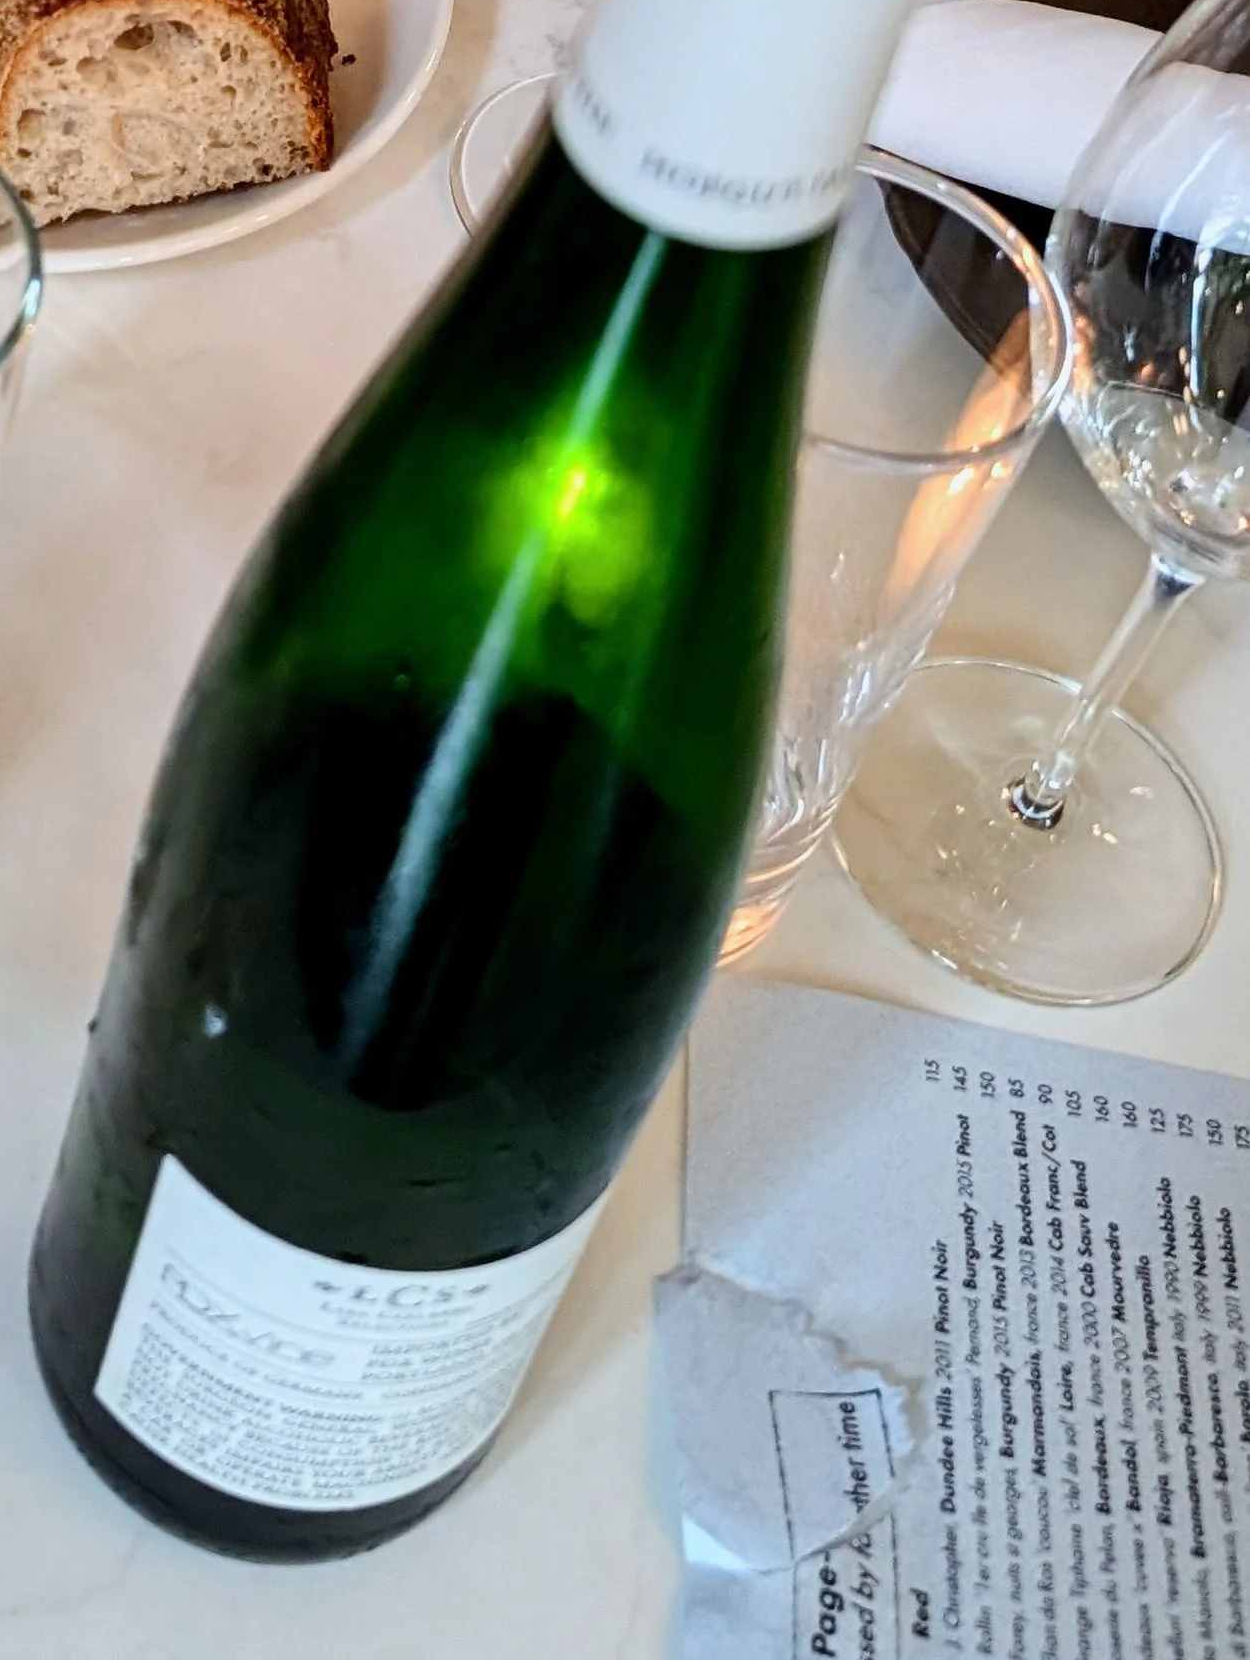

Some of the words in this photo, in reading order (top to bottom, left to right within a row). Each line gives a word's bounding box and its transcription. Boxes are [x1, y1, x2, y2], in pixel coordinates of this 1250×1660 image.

[924, 1059, 940, 1082] 115
[952, 1066, 967, 1093] 145
[980, 1071, 995, 1098] 150
[1008, 1078, 1024, 1098] 85
[1037, 1084, 1053, 1105] 90
[1065, 1090, 1081, 1116] 105
[1093, 1095, 1109, 1122] 160
[1121, 1101, 1138, 1128] 160
[955, 1114, 971, 1157] Pinot
[1010, 1110, 1028, 1158] Blend
[1149, 1108, 1165, 1133] 125
[1177, 1114, 1193, 1138] 175
[1206, 1119, 1222, 1146] 150
[957, 1159, 973, 1199] 2015
[1040, 1123, 1062, 1212] Franc/Cot
[1070, 1160, 1089, 1209] Blend
[1016, 1161, 1034, 1247] Bordeaux
[1157, 1177, 1177, 1258] Nebbiolo
[958, 1203, 980, 1290] Burgundy
[988, 1221, 1005, 1260] Noir
[1048, 1217, 1064, 1251] Cab
[1076, 1213, 1093, 1257] Sauv
[1187, 1195, 1207, 1277] Nebbiolo
[1216, 1208, 1238, 1290] Nebbiolo
[931, 1239, 948, 1281] Noir
[1019, 1249, 1037, 1289] 2013
[1050, 1256, 1067, 1296] 2014
[1077, 1262, 1096, 1298] Cab
[1104, 1221, 1126, 1323] Mourvedre
[933, 1285, 950, 1334] Pinot
[991, 1265, 1007, 1310] Pinot
[1135, 1255, 1159, 1361] Tempranillo
[993, 1316, 1010, 1357] 2015
[1022, 1293, 1039, 1344] france
[1054, 1302, 1071, 1353] france
[1081, 1301, 1099, 1349] 2000
[935, 1340, 951, 1381] 2011
[1111, 1326, 1131, 1374] 2007
[1057, 1361, 1075, 1412] Loire,
[1086, 1354, 1103, 1406] france
[1143, 1364, 1163, 1412] 2009
[836, 1401, 862, 1451] time
[935, 1386, 953, 1430] Hills
[995, 1363, 1017, 1458] Burgundy
[1025, 1348, 1047, 1476] Marmandais,
[1119, 1378, 1135, 1430] france
[937, 1436, 957, 1513] Dundee
[1120, 1438, 1141, 1512] Bandol
[850, 1562, 879, 1600] by
[909, 1588, 930, 1639] Red
